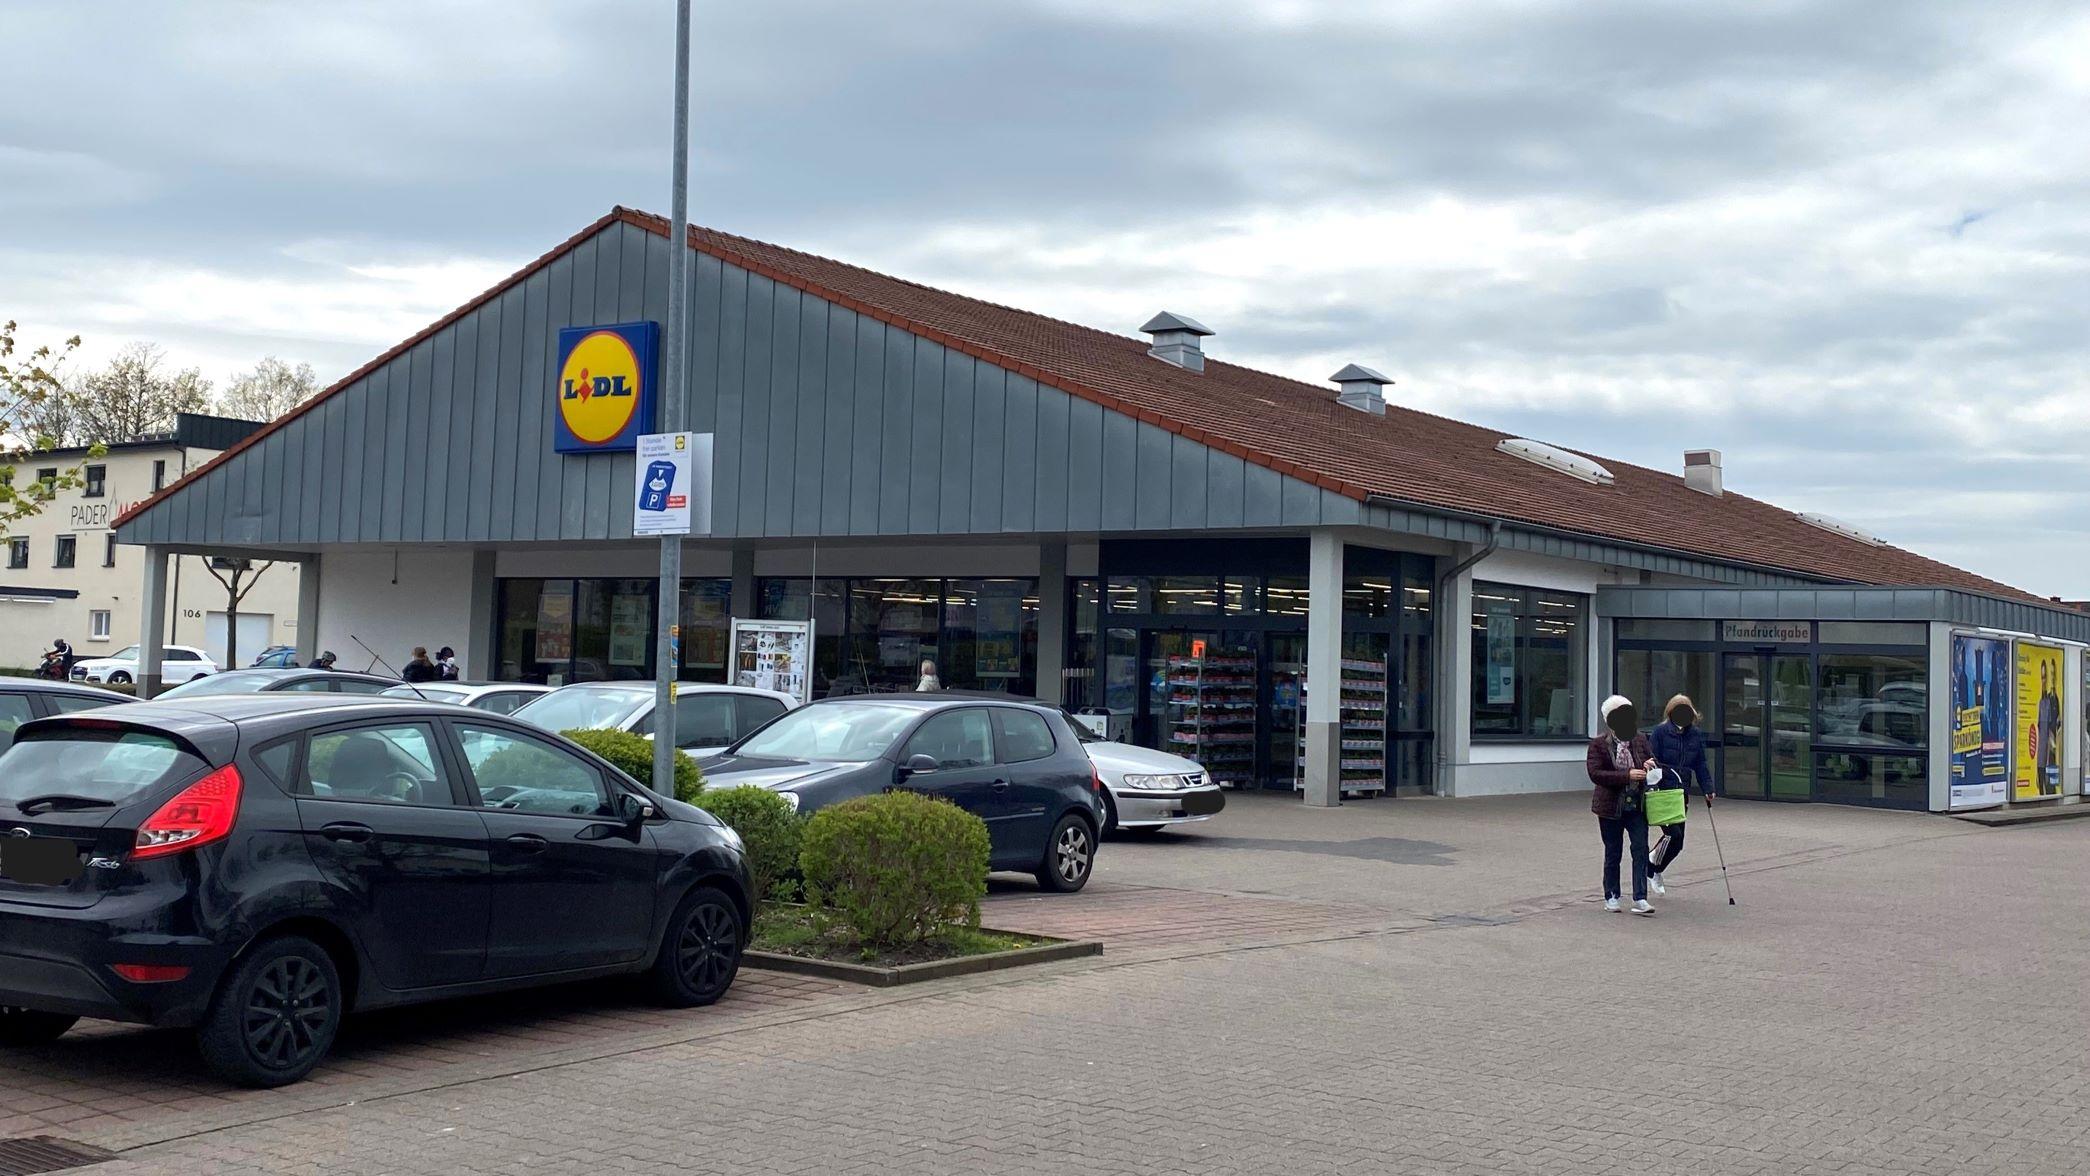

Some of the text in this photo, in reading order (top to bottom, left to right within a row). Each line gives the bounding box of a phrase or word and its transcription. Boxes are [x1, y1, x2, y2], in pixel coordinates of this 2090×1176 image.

[71, 504, 107, 525] PADER
[183, 609, 201, 618] 106
[1726, 624, 1808, 641] Pfandrückgabe
